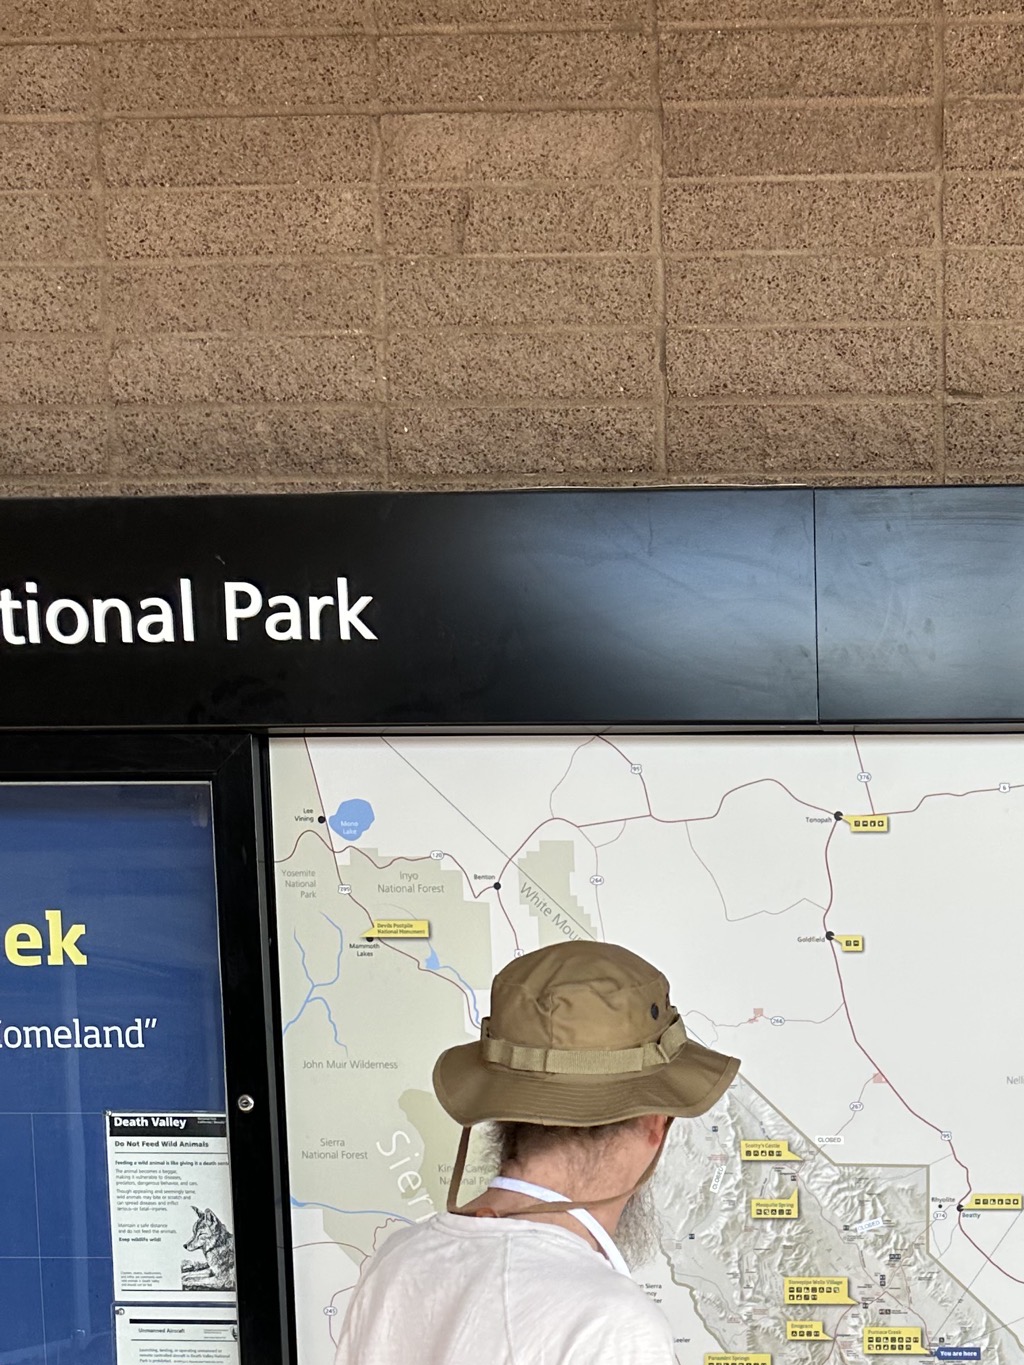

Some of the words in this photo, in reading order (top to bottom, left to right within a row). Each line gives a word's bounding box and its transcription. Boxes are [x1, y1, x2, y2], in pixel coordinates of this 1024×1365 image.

[224, 577, 378, 642] Park
[400, 871, 418, 881] Inyo
[378, 884, 415, 893] National
[418, 884, 444, 893] Forest
[520, 882, 553, 916] White
[303, 1060, 323, 1069] John
[327, 1060, 347, 1069] Muir
[350, 1060, 398, 1069] Wilderness
[114, 1117, 148, 1126] Death
[151, 1117, 186, 1129] Valley
[320, 1138, 345, 1147] Sierra
[817, 1136, 842, 1144] CLOSED
[302, 1151, 338, 1159] National
[341, 1151, 368, 1159] Forest
